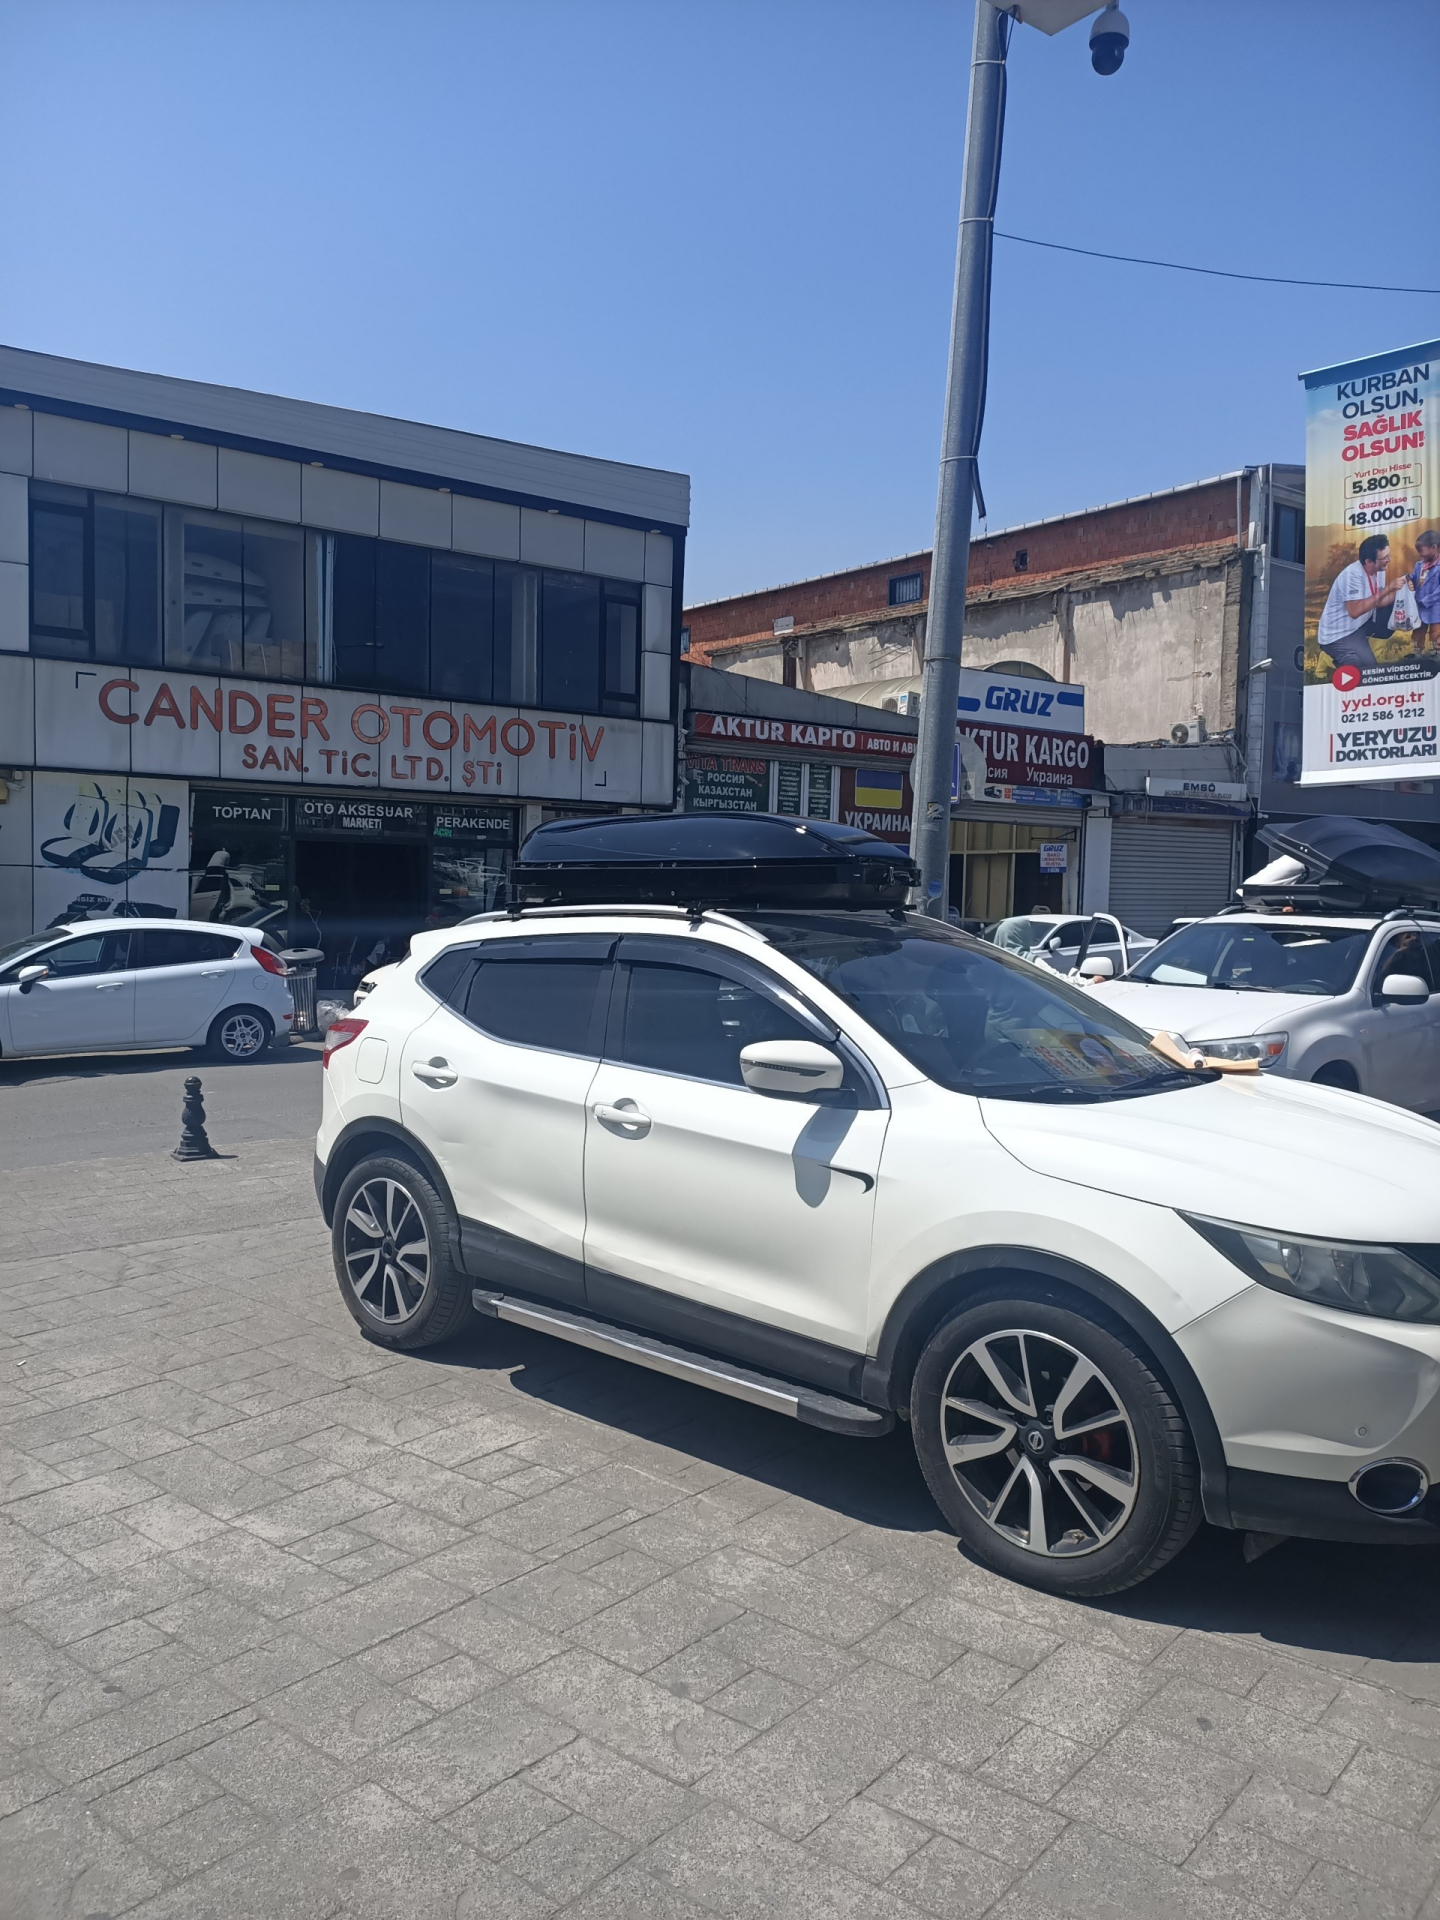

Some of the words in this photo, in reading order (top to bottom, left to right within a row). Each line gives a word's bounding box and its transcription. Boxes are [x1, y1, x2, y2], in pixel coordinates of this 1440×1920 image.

[1337, 363, 1430, 401] KURBAN
[1342, 387, 1424, 419] OLSUN,
[1343, 409, 1423, 441] SAĞLIK
[1341, 430, 1425, 462] OLSUN!
[1354, 470, 1371, 478] Yurt
[1372, 467, 1388, 476] Dışı
[1389, 463, 1412, 473] Hisse
[1352, 473, 1400, 494] 5.800
[1402, 476, 1414, 485] TL
[1358, 500, 1383, 510] Gazze
[1385, 496, 1408, 506] Hisse
[1348, 505, 1405, 526] 18.000
[1406, 508, 1418, 517] TL
[1362, 667, 1385, 676] KESİM
[1386, 664, 1421, 673] VİDEOSU
[1362, 670, 1434, 684] GÖNDERİLECEKTİR.
[98, 678, 330, 741] CANDER
[985, 685, 1055, 717] GRUZ
[1341, 691, 1425, 713] yyd.org.tr
[1341, 712, 1369, 723] 0212
[1372, 710, 1394, 721] 586
[1398, 707, 1425, 718] 1212
[711, 715, 785, 742] AKTUR
[791, 725, 856, 748] КАРГО
[867, 738, 891, 751] АВТО
[893, 741, 899, 752] И
[1337, 725, 1437, 748] YERYÜZÜ
[1025, 734, 1090, 769] KARGO
[1335, 743, 1437, 762] DOKTORLARI
[242, 743, 309, 773] SAN.
[391, 754, 450, 782] LTD.
[721, 756, 766, 775] TRANS
[707, 772, 745, 784] РОССИЯ
[1026, 766, 1073, 786] Украина
[698, 785, 753, 797] КАЗАХСТАН
[212, 805, 271, 820] TOPTAN
[304, 802, 335, 815] OTO
[337, 804, 413, 818] AKSESUAR
[693, 797, 757, 811] КЫРГЫЗСТАН
[436, 816, 510, 830] PERAKENDE
[844, 810, 911, 833] УКРАИНА
[1043, 844, 1064, 852] GRUZ
